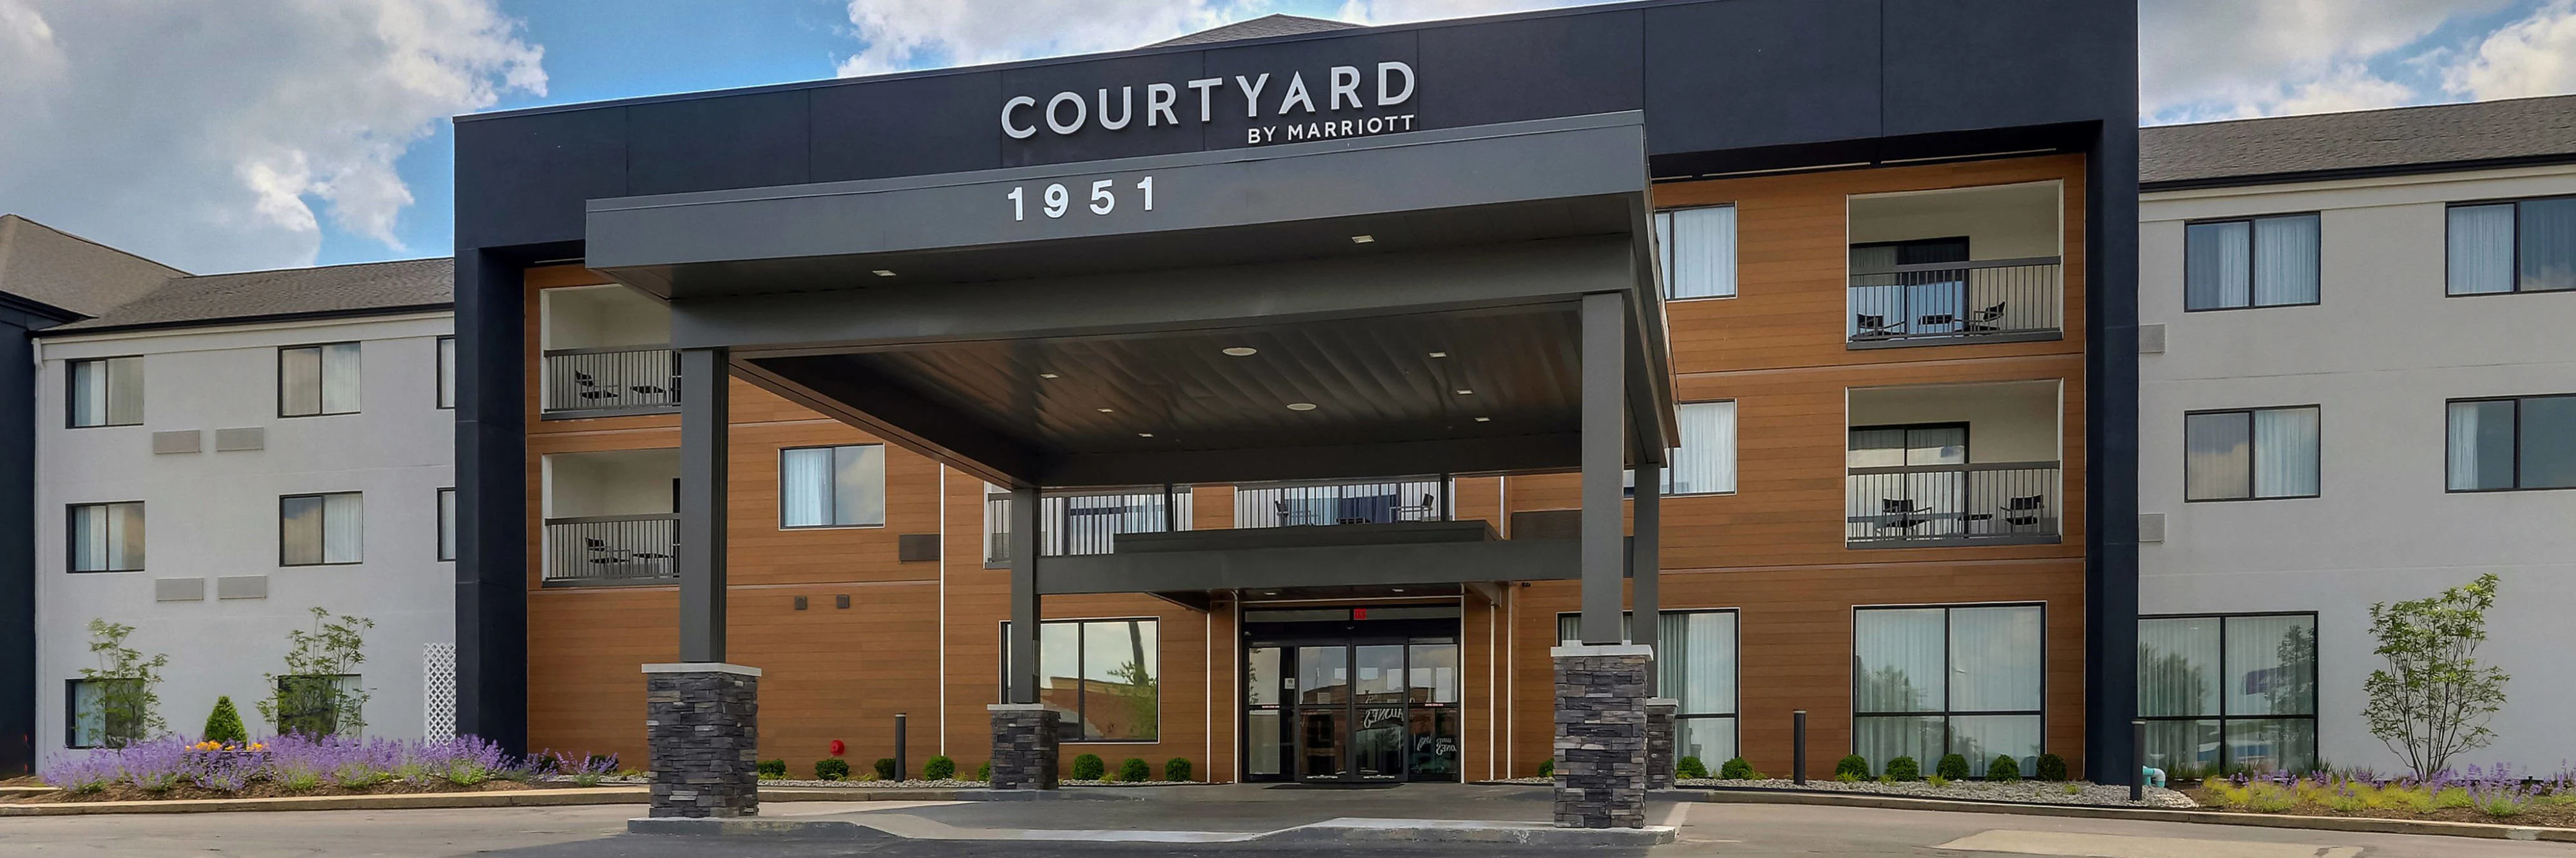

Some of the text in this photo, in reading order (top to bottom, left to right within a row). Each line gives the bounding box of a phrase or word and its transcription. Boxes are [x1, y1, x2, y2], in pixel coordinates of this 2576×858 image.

[1000, 61, 1416, 139] COURTYARD
[1247, 114, 1415, 145] BY MARRIOTT
[1007, 176, 1153, 221] 1951
